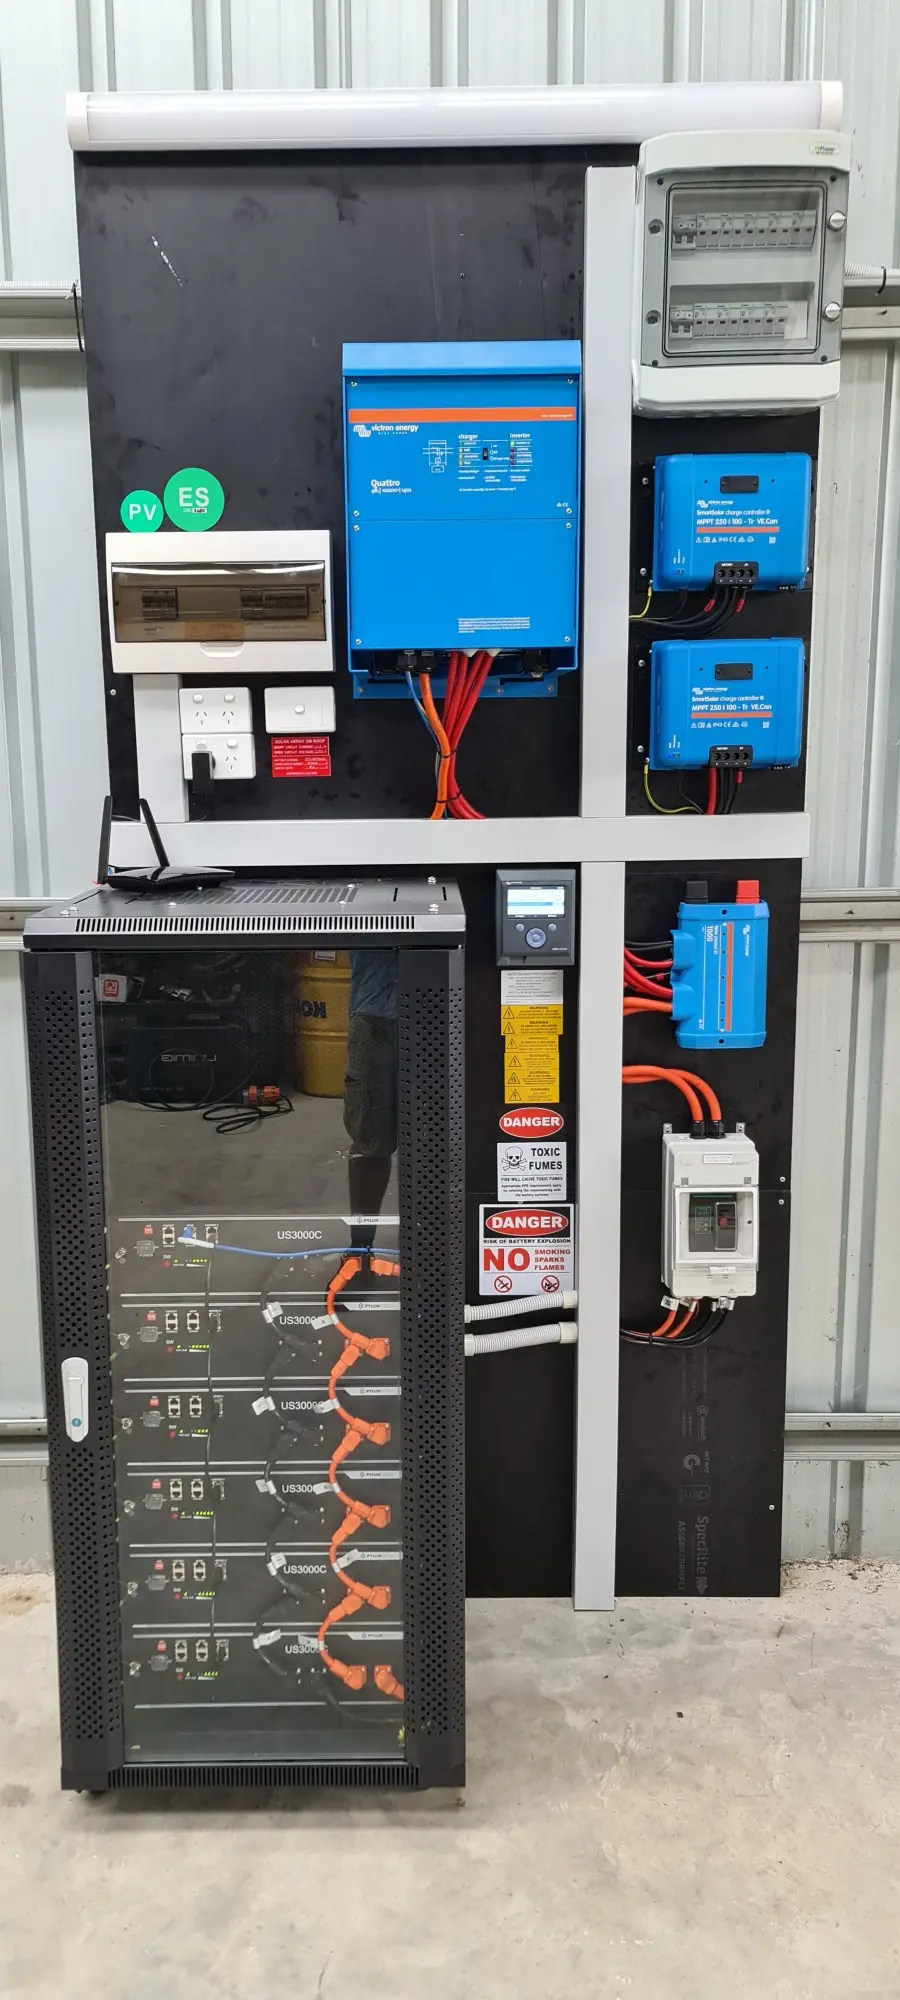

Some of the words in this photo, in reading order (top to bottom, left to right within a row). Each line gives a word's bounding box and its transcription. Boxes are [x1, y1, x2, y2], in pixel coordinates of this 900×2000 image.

[370, 480, 400, 488] Quattro
[178, 486, 209, 507] ES
[128, 504, 156, 521] PV
[503, 1116, 560, 1127] DANGER
[531, 1148, 560, 1156] TOXIC
[529, 1161, 562, 1170] FUMES
[492, 1216, 562, 1228] DANGER
[277, 1231, 322, 1239] US3000C
[484, 1248, 530, 1271] NO
[283, 1566, 326, 1574] US3000C
